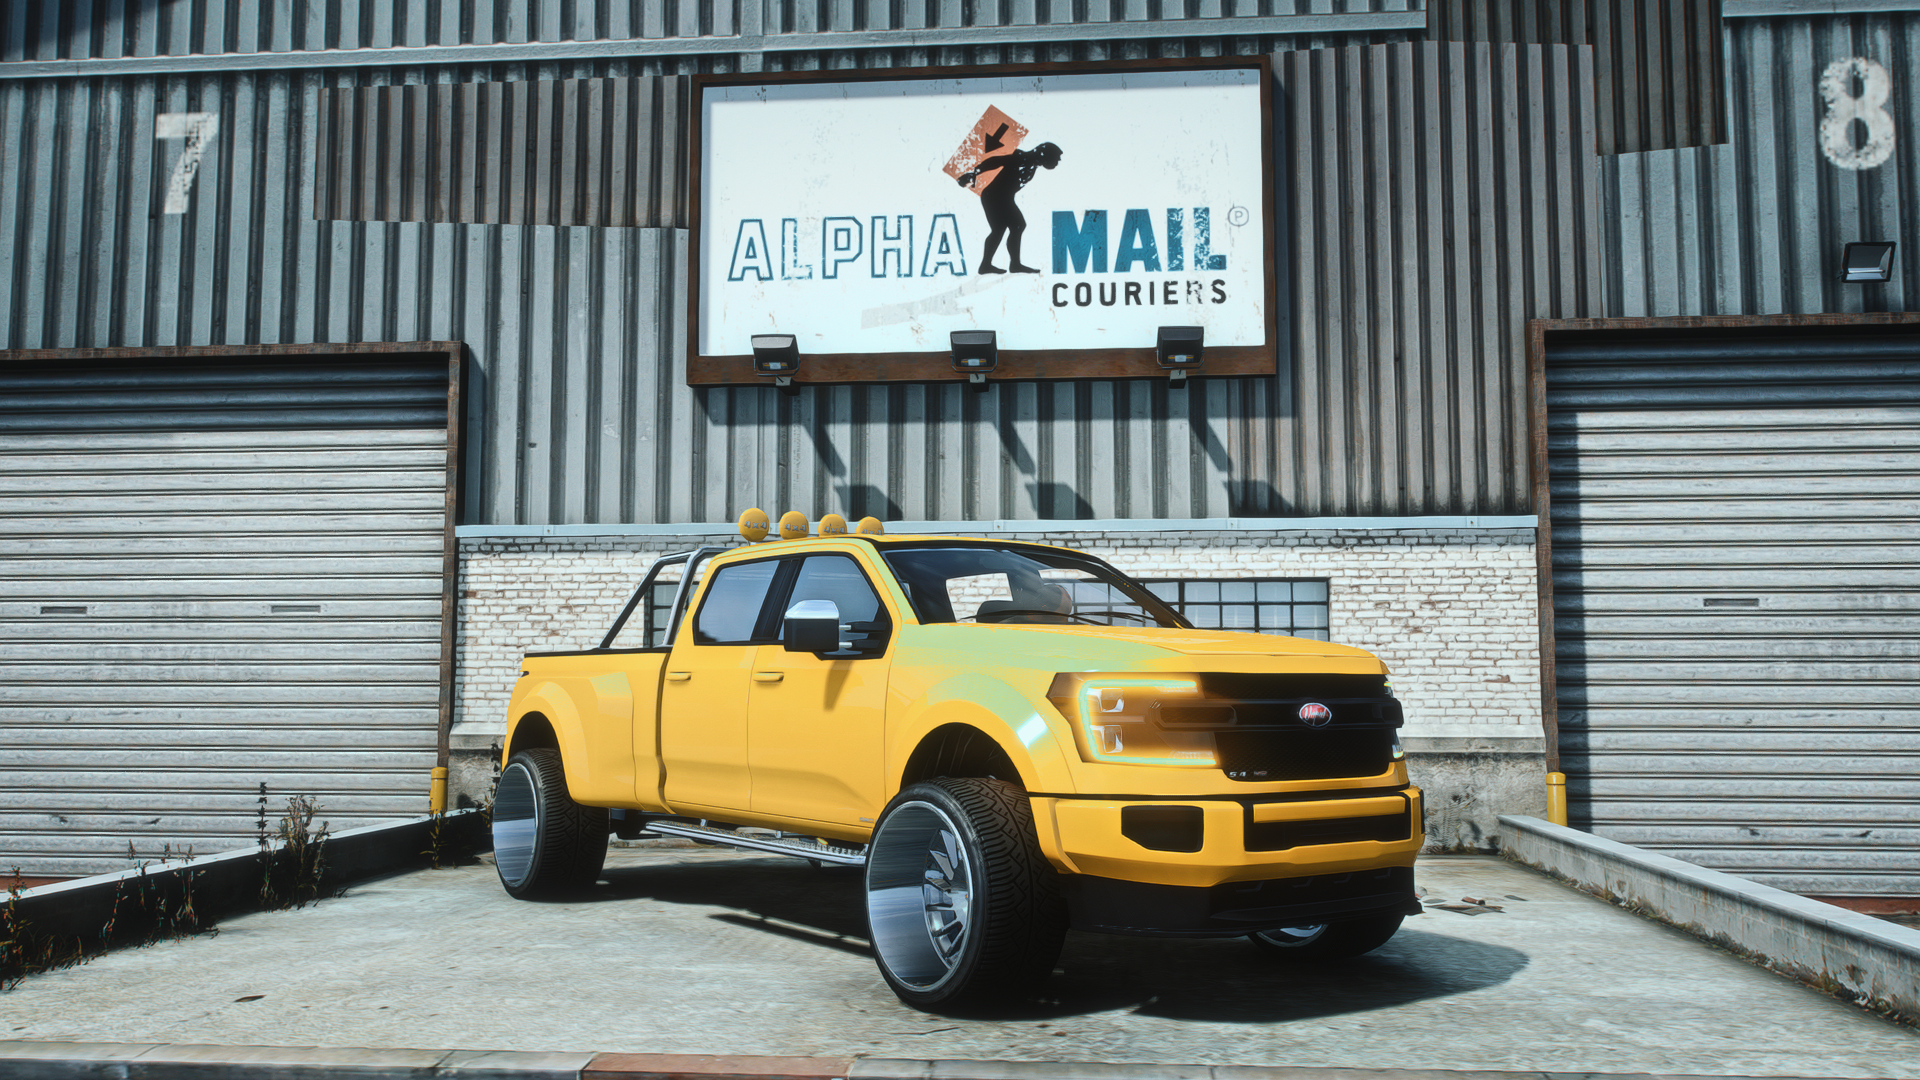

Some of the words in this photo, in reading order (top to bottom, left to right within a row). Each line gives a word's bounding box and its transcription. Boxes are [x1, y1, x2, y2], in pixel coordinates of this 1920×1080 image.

[1819, 57, 1895, 170] 8
[156, 112, 219, 214] 7
[727, 213, 968, 282] ALPHA
[1051, 207, 1227, 274] MAIL
[1052, 279, 1227, 308] COURIERS
[744, 520, 768, 530] 4x4
[784, 523, 807, 532] 4x4
[823, 526, 845, 535] 4x4
